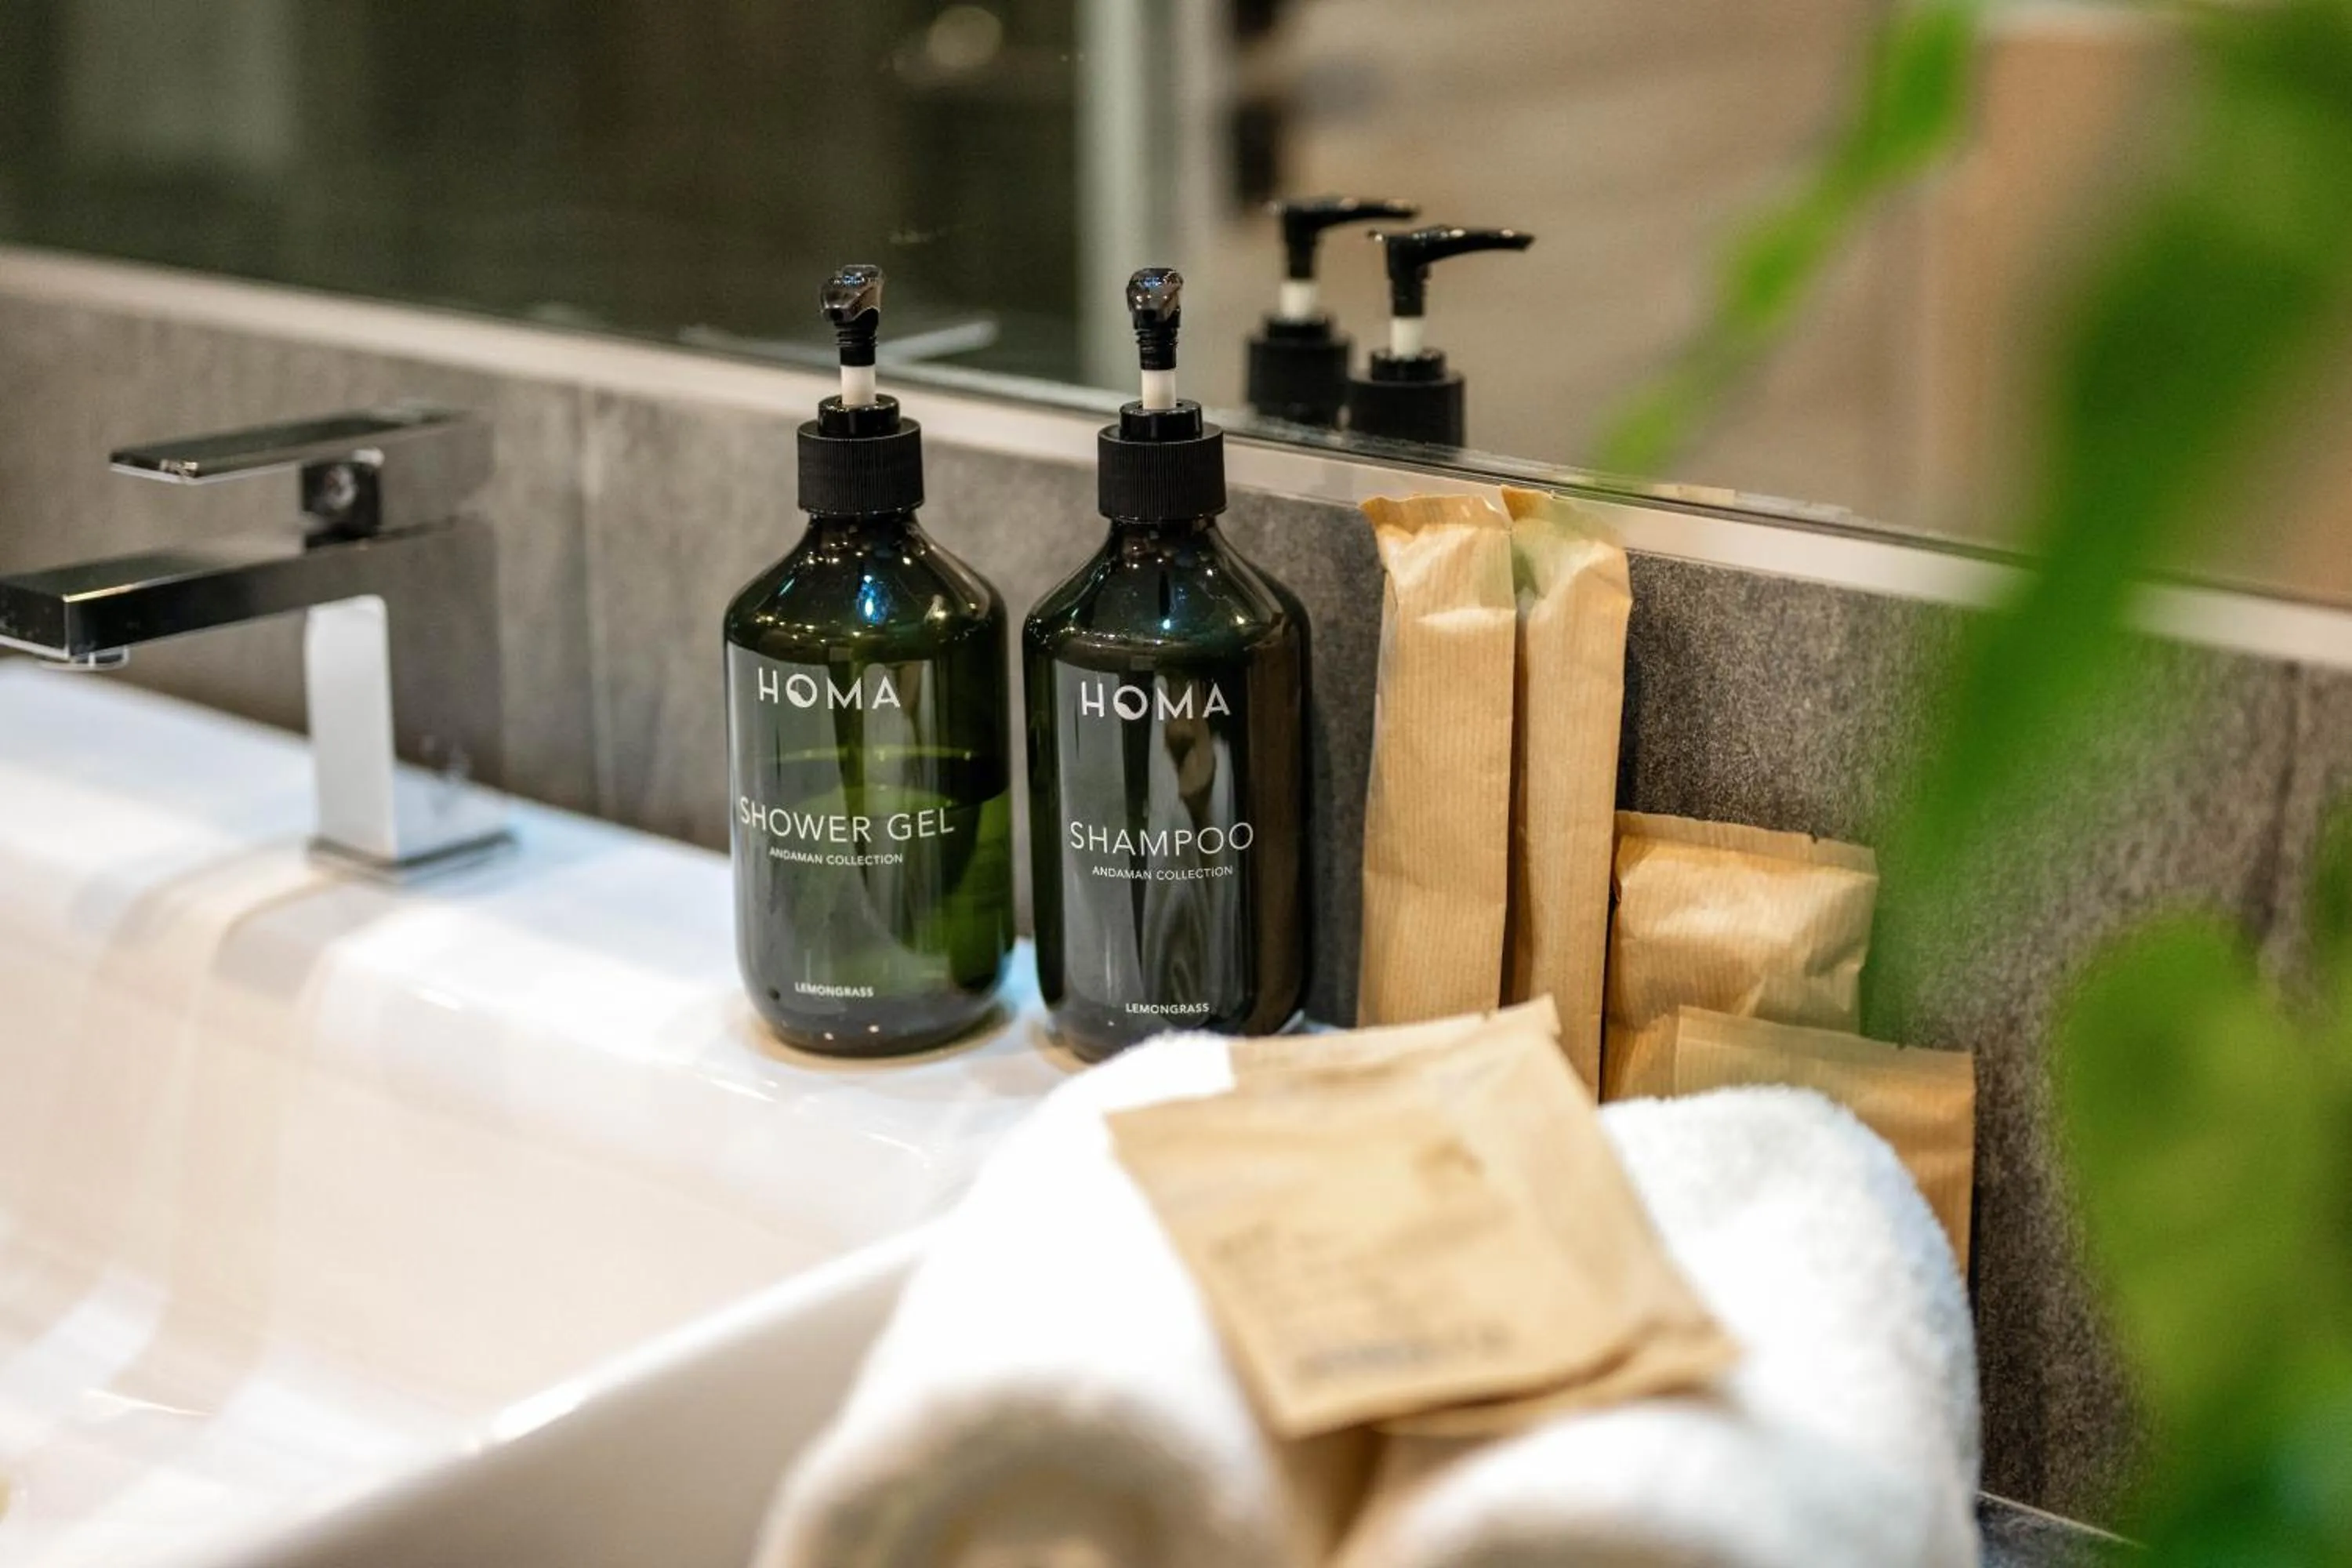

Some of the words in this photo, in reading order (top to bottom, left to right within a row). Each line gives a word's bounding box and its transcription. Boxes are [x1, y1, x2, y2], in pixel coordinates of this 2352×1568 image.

[758, 667, 901, 710] HOMA
[1081, 681, 1231, 720] HOMA
[739, 796, 873, 844] SHOWER
[887, 807, 955, 841] GEL
[1069, 821, 1254, 857] SHAMPOO
[769, 846, 824, 865] ANDAMAN
[826, 852, 904, 866] COLLECTION
[1092, 865, 1152, 880] ANDAMAN
[1156, 865, 1233, 881] COLLECTION
[794, 982, 874, 998] LEMONGRASS
[1125, 1002, 1210, 1015] LEMONGRASS
